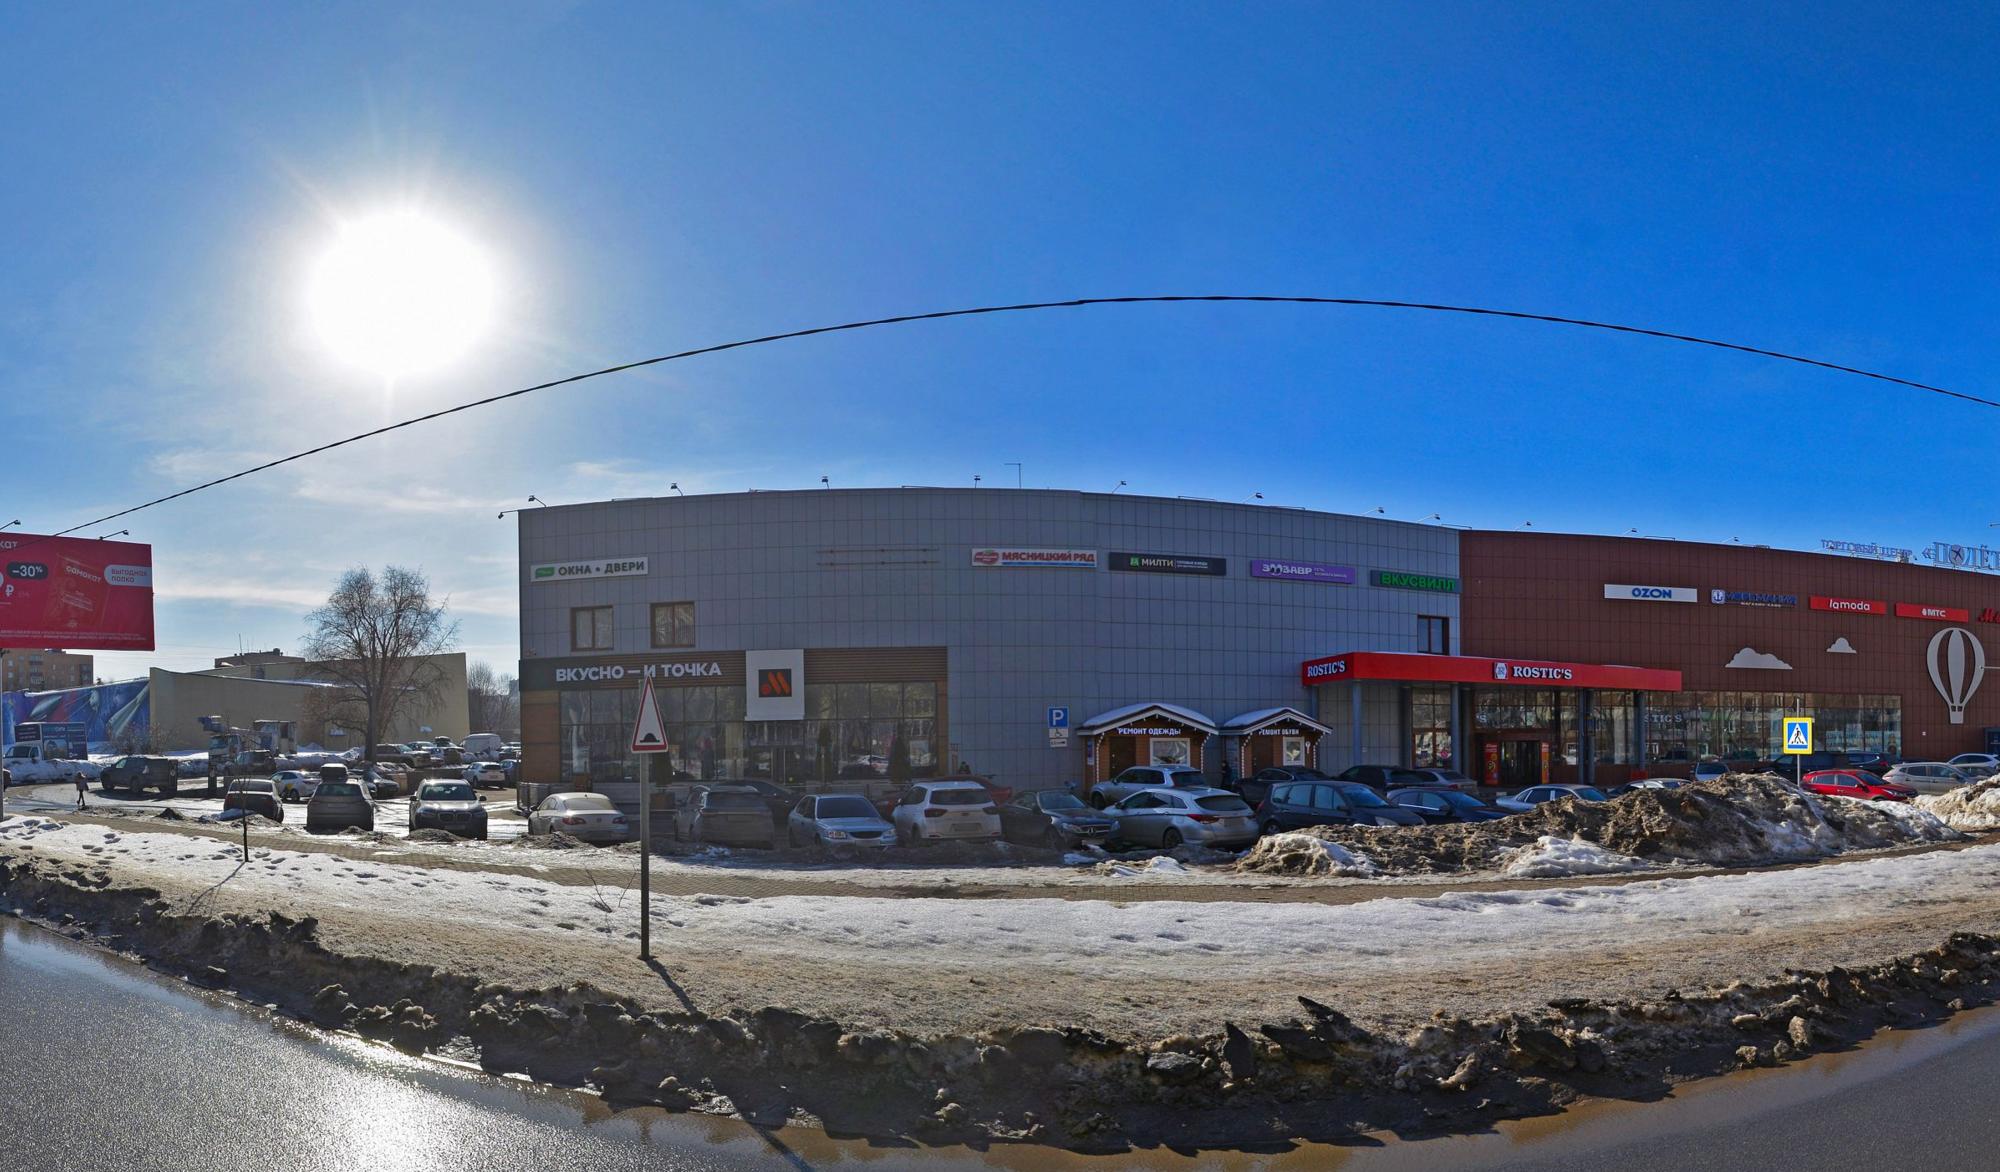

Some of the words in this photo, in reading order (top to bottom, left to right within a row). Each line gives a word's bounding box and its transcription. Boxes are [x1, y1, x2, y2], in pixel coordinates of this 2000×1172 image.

[1002, 550, 1072, 562] МЯСНИЦКИЙ
[1074, 552, 1095, 562] РЯД
[558, 565, 592, 576] ОКНА
[604, 561, 644, 574] ДВЕРИ
[1141, 558, 1174, 568] МИЛТИ
[1382, 571, 1456, 592] ВКУСВИЛЛ
[1631, 587, 1672, 599] OZON
[1829, 598, 1871, 611] lamoda
[556, 665, 625, 682] ВКУСНО
[643, 664, 656, 678] И
[661, 662, 722, 677] ТОЧКА
[1307, 660, 1346, 677] ROSTIC'S
[1512, 666, 1573, 679] ROSTIC'S
[1118, 727, 1147, 735] РЕМОНТ
[1148, 727, 1182, 736] ОДЕЖДЫ
